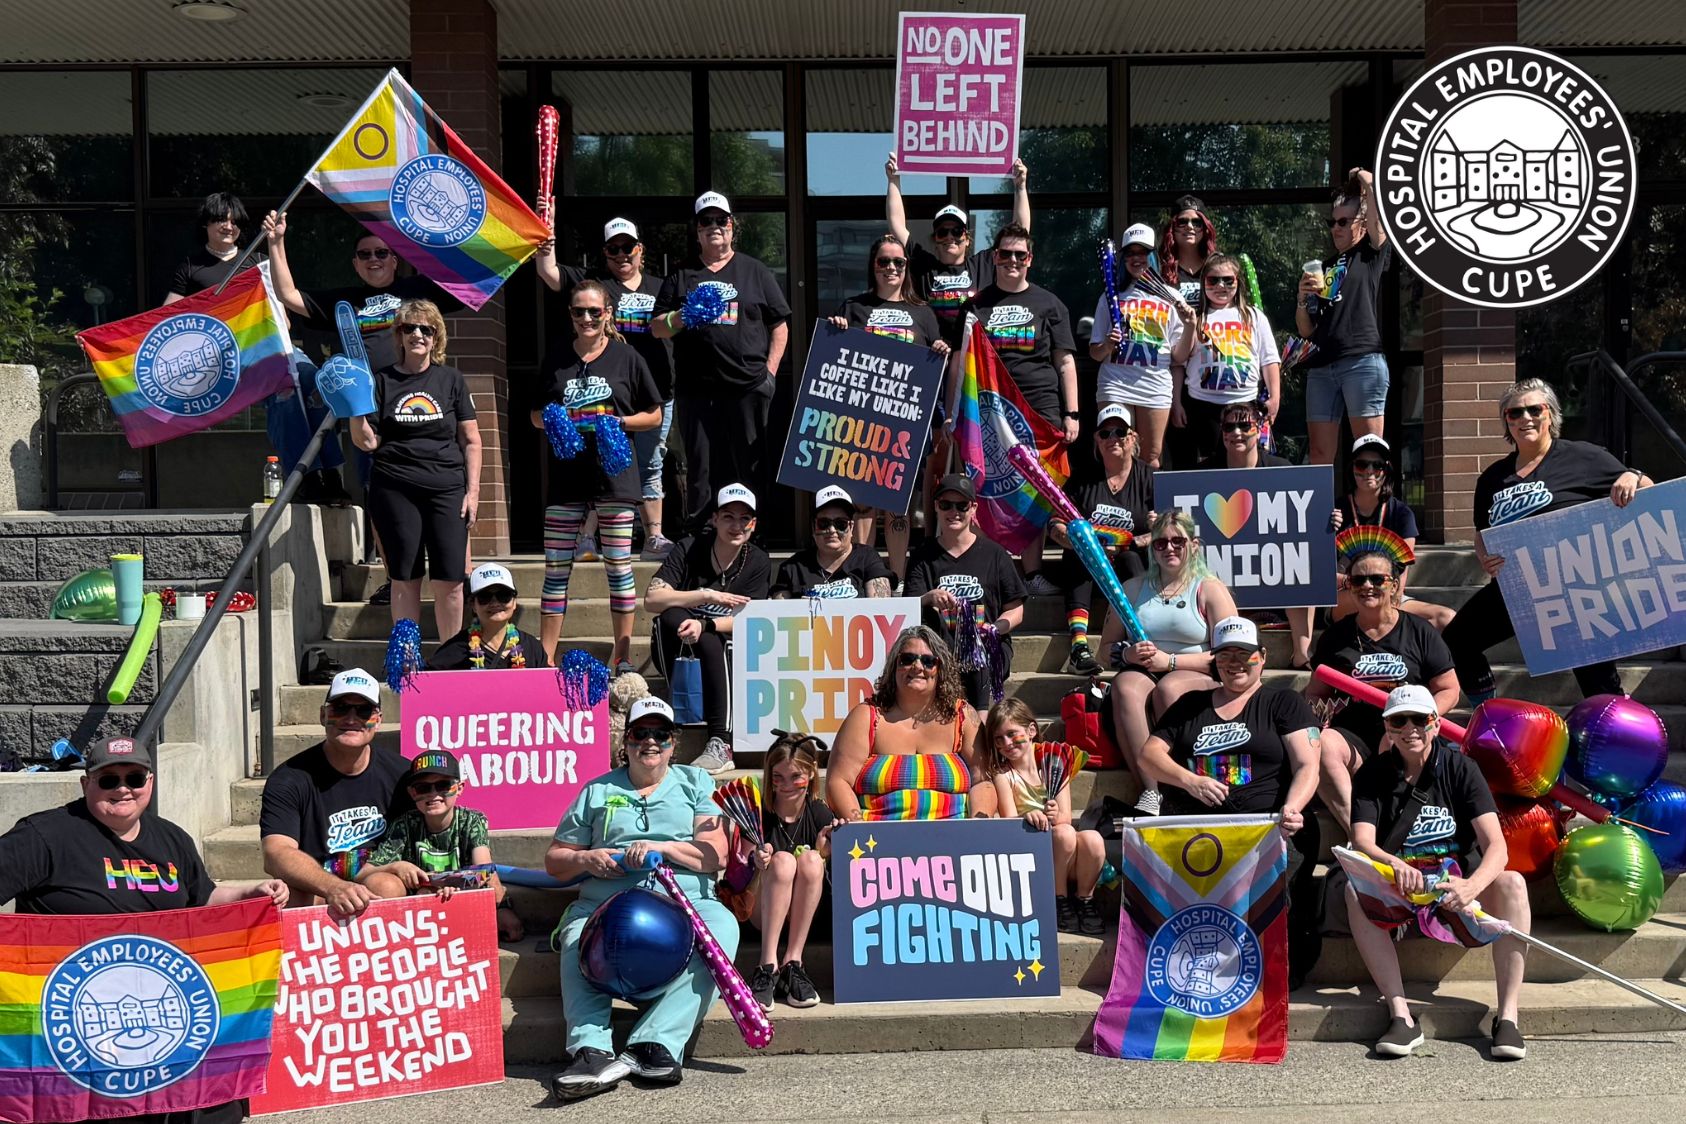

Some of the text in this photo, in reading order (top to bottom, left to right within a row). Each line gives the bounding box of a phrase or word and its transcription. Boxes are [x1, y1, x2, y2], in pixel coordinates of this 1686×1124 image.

[907, 27, 1012, 66] NO ONE
[911, 74, 1006, 112] LEFT
[904, 120, 1008, 153] BEHIND
[393, 159, 482, 244] HOSPITAL EMPLOYEES' UNION
[399, 217, 430, 243] CUPE
[820, 362, 922, 402] COFFEE LIKE I
[837, 348, 914, 380] I LIKE MY
[563, 384, 612, 404] Team
[808, 379, 923, 421] LIKE MY UNION:
[419, 413, 444, 422] PRIDE
[799, 407, 911, 459] PROUD &
[795, 440, 905, 490] STRONG
[1490, 489, 1552, 524] Team
[1504, 483, 1534, 498] TAKES
[1091, 511, 1133, 530] Team
[1257, 490, 1314, 534] MY
[1201, 541, 1310, 587] NION
[1515, 509, 1684, 600] UNION
[1534, 564, 1686, 650] PRIDE
[747, 615, 907, 672] PINOY
[1352, 662, 1408, 680] Team
[415, 711, 595, 750] QUEERING
[1194, 730, 1251, 751] Team
[459, 750, 578, 787] ABOUR
[331, 814, 341, 824] IT
[343, 807, 370, 820] TAKES
[1409, 817, 1456, 837] eam
[1421, 807, 1440, 816] KES
[328, 817, 386, 846] Team
[104, 857, 179, 892] HEU
[960, 853, 1036, 918] OUT
[298, 909, 449, 955] UNIONS:
[853, 903, 1041, 966] FIGHTING
[1171, 910, 1237, 935] HOSPITAL
[280, 937, 468, 985] THE PEOPLE
[1150, 945, 1166, 987] CUPE
[51, 943, 212, 1071] HOSPITAL EMPLOYEES' UNION
[341, 960, 490, 1020] BROUGHT
[1166, 992, 1213, 1013] UNION
[295, 1008, 442, 1066] YOU THE
[104, 1064, 172, 1091] CUPE
[283, 1032, 472, 1093] WEEKEND
